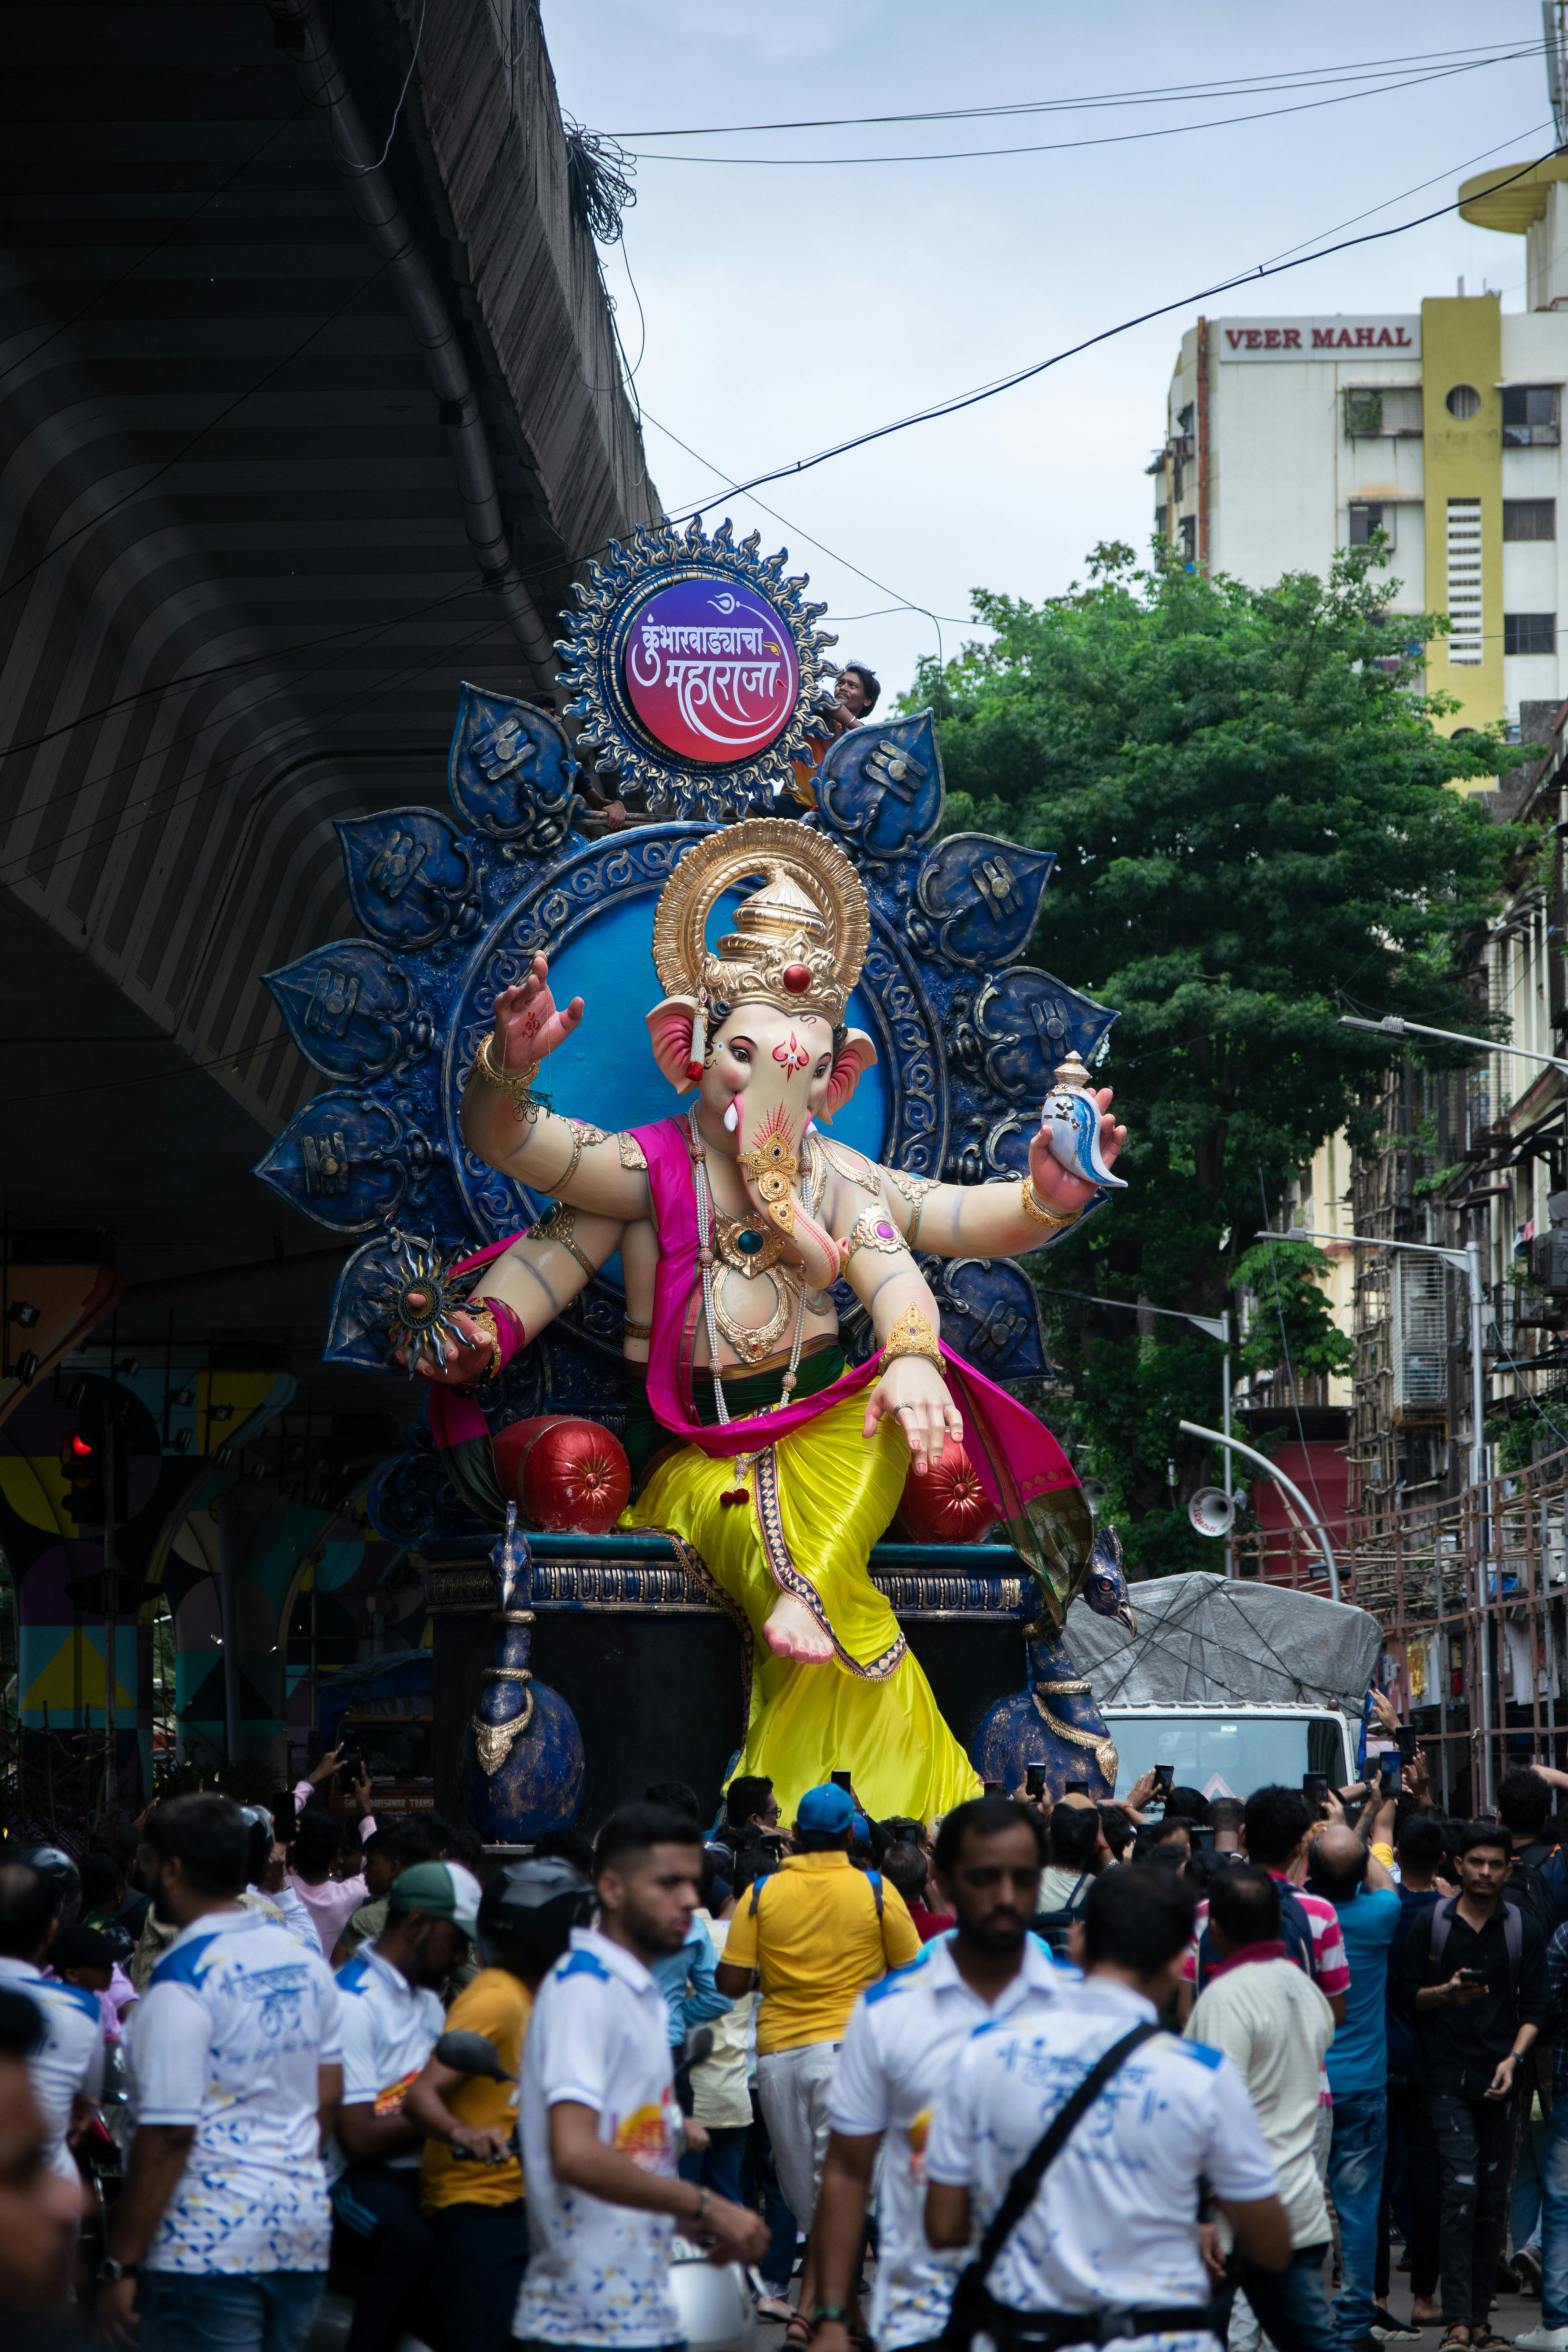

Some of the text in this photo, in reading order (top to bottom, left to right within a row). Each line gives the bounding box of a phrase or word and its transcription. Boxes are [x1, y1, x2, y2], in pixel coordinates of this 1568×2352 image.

[1225, 326, 1412, 350] VEER MAHAL
[632, 614, 764, 686] कुंभारवाड्याचा
[666, 660, 784, 744] महाराजा
